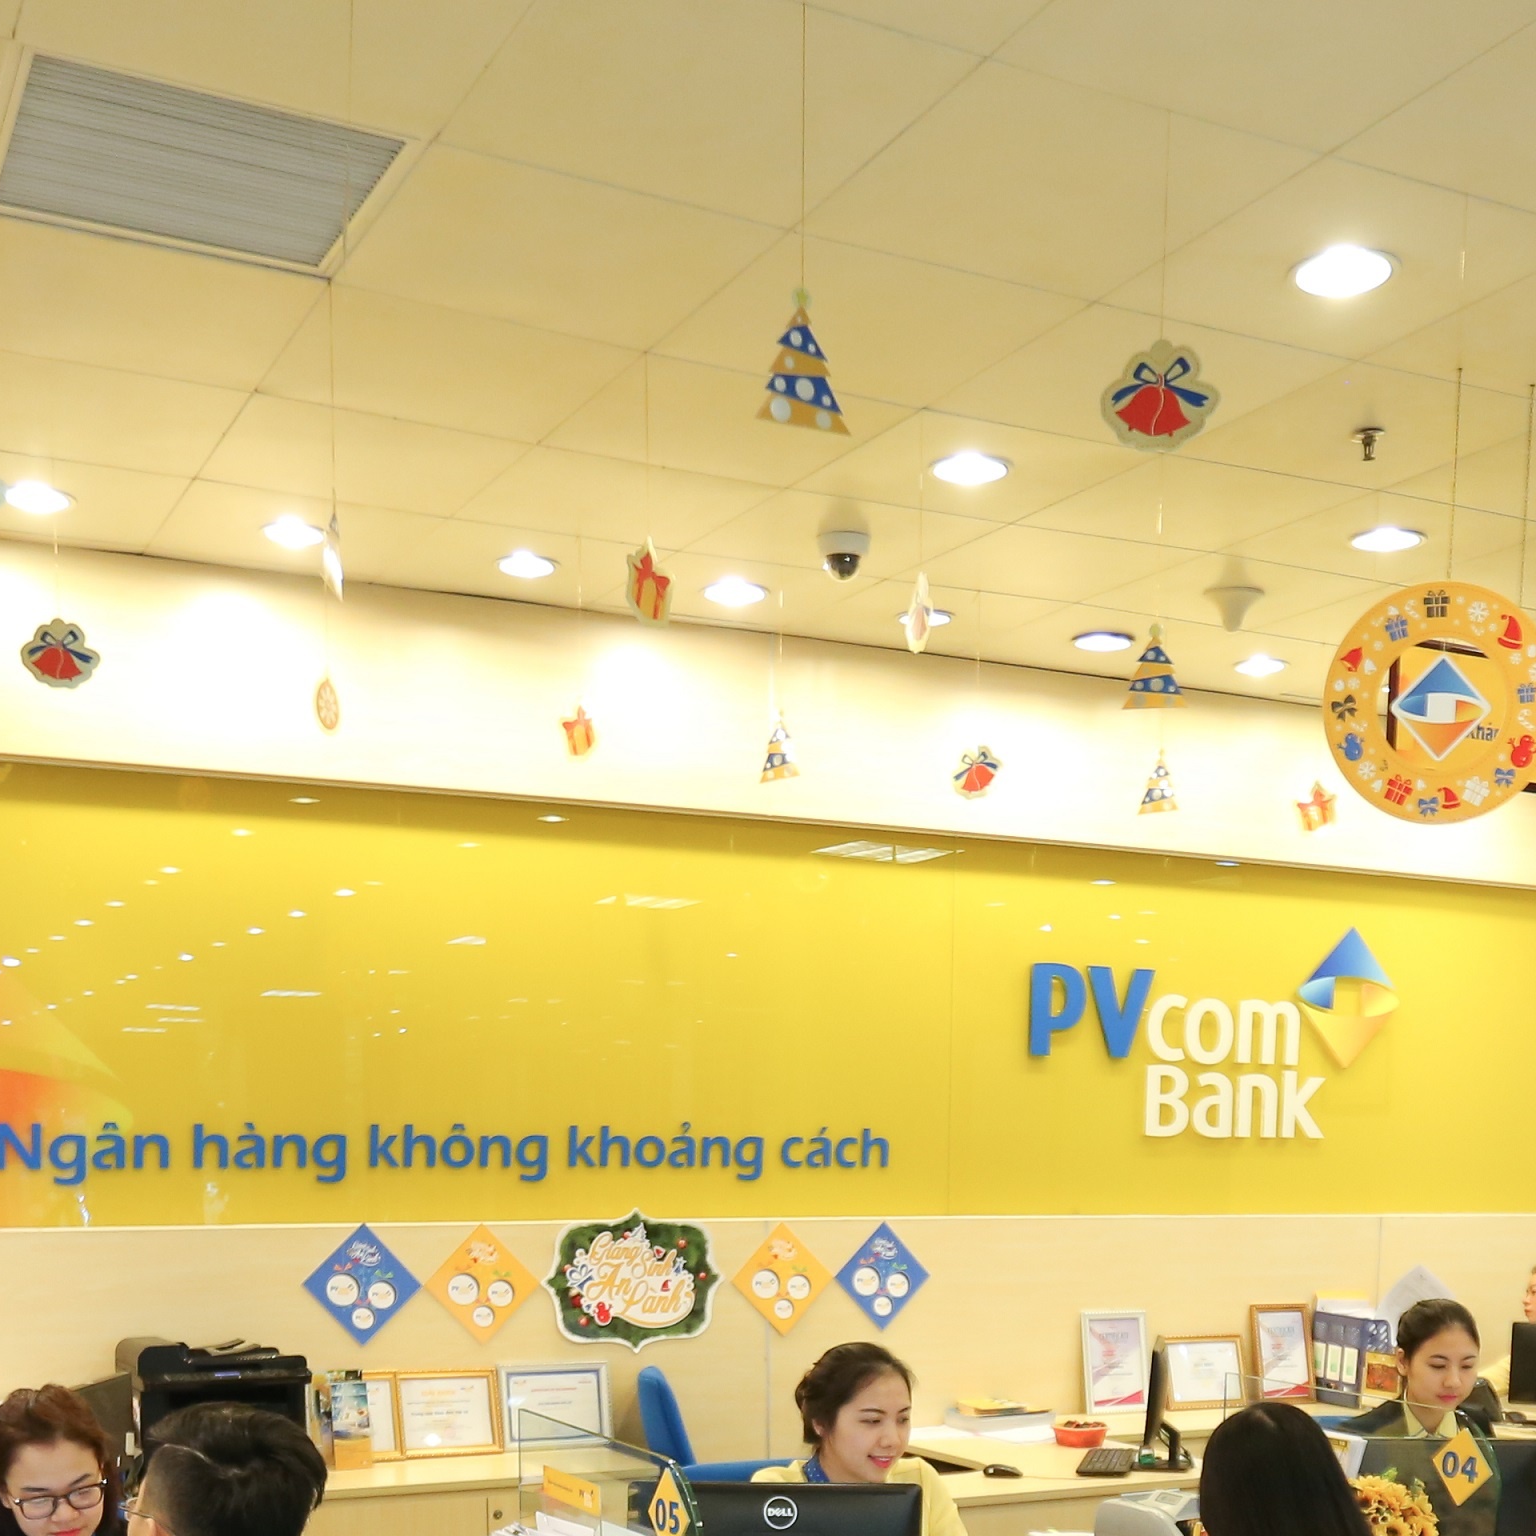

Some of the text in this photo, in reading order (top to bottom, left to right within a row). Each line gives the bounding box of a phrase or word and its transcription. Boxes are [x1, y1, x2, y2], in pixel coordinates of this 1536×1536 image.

[1029, 962, 1302, 1067] PVcom
[1143, 1064, 1327, 1138] Bank
[193, 1121, 347, 1183] hàng
[369, 1122, 549, 1182] không
[567, 1120, 764, 1181] khoảng
[781, 1126, 888, 1168] cách
[631, 1250, 677, 1280] Sinh
[584, 1261, 693, 1327] An Lành
[1442, 1451, 1478, 1484] 04
[655, 1498, 680, 1535] 05
[767, 1507, 794, 1517] DELL
